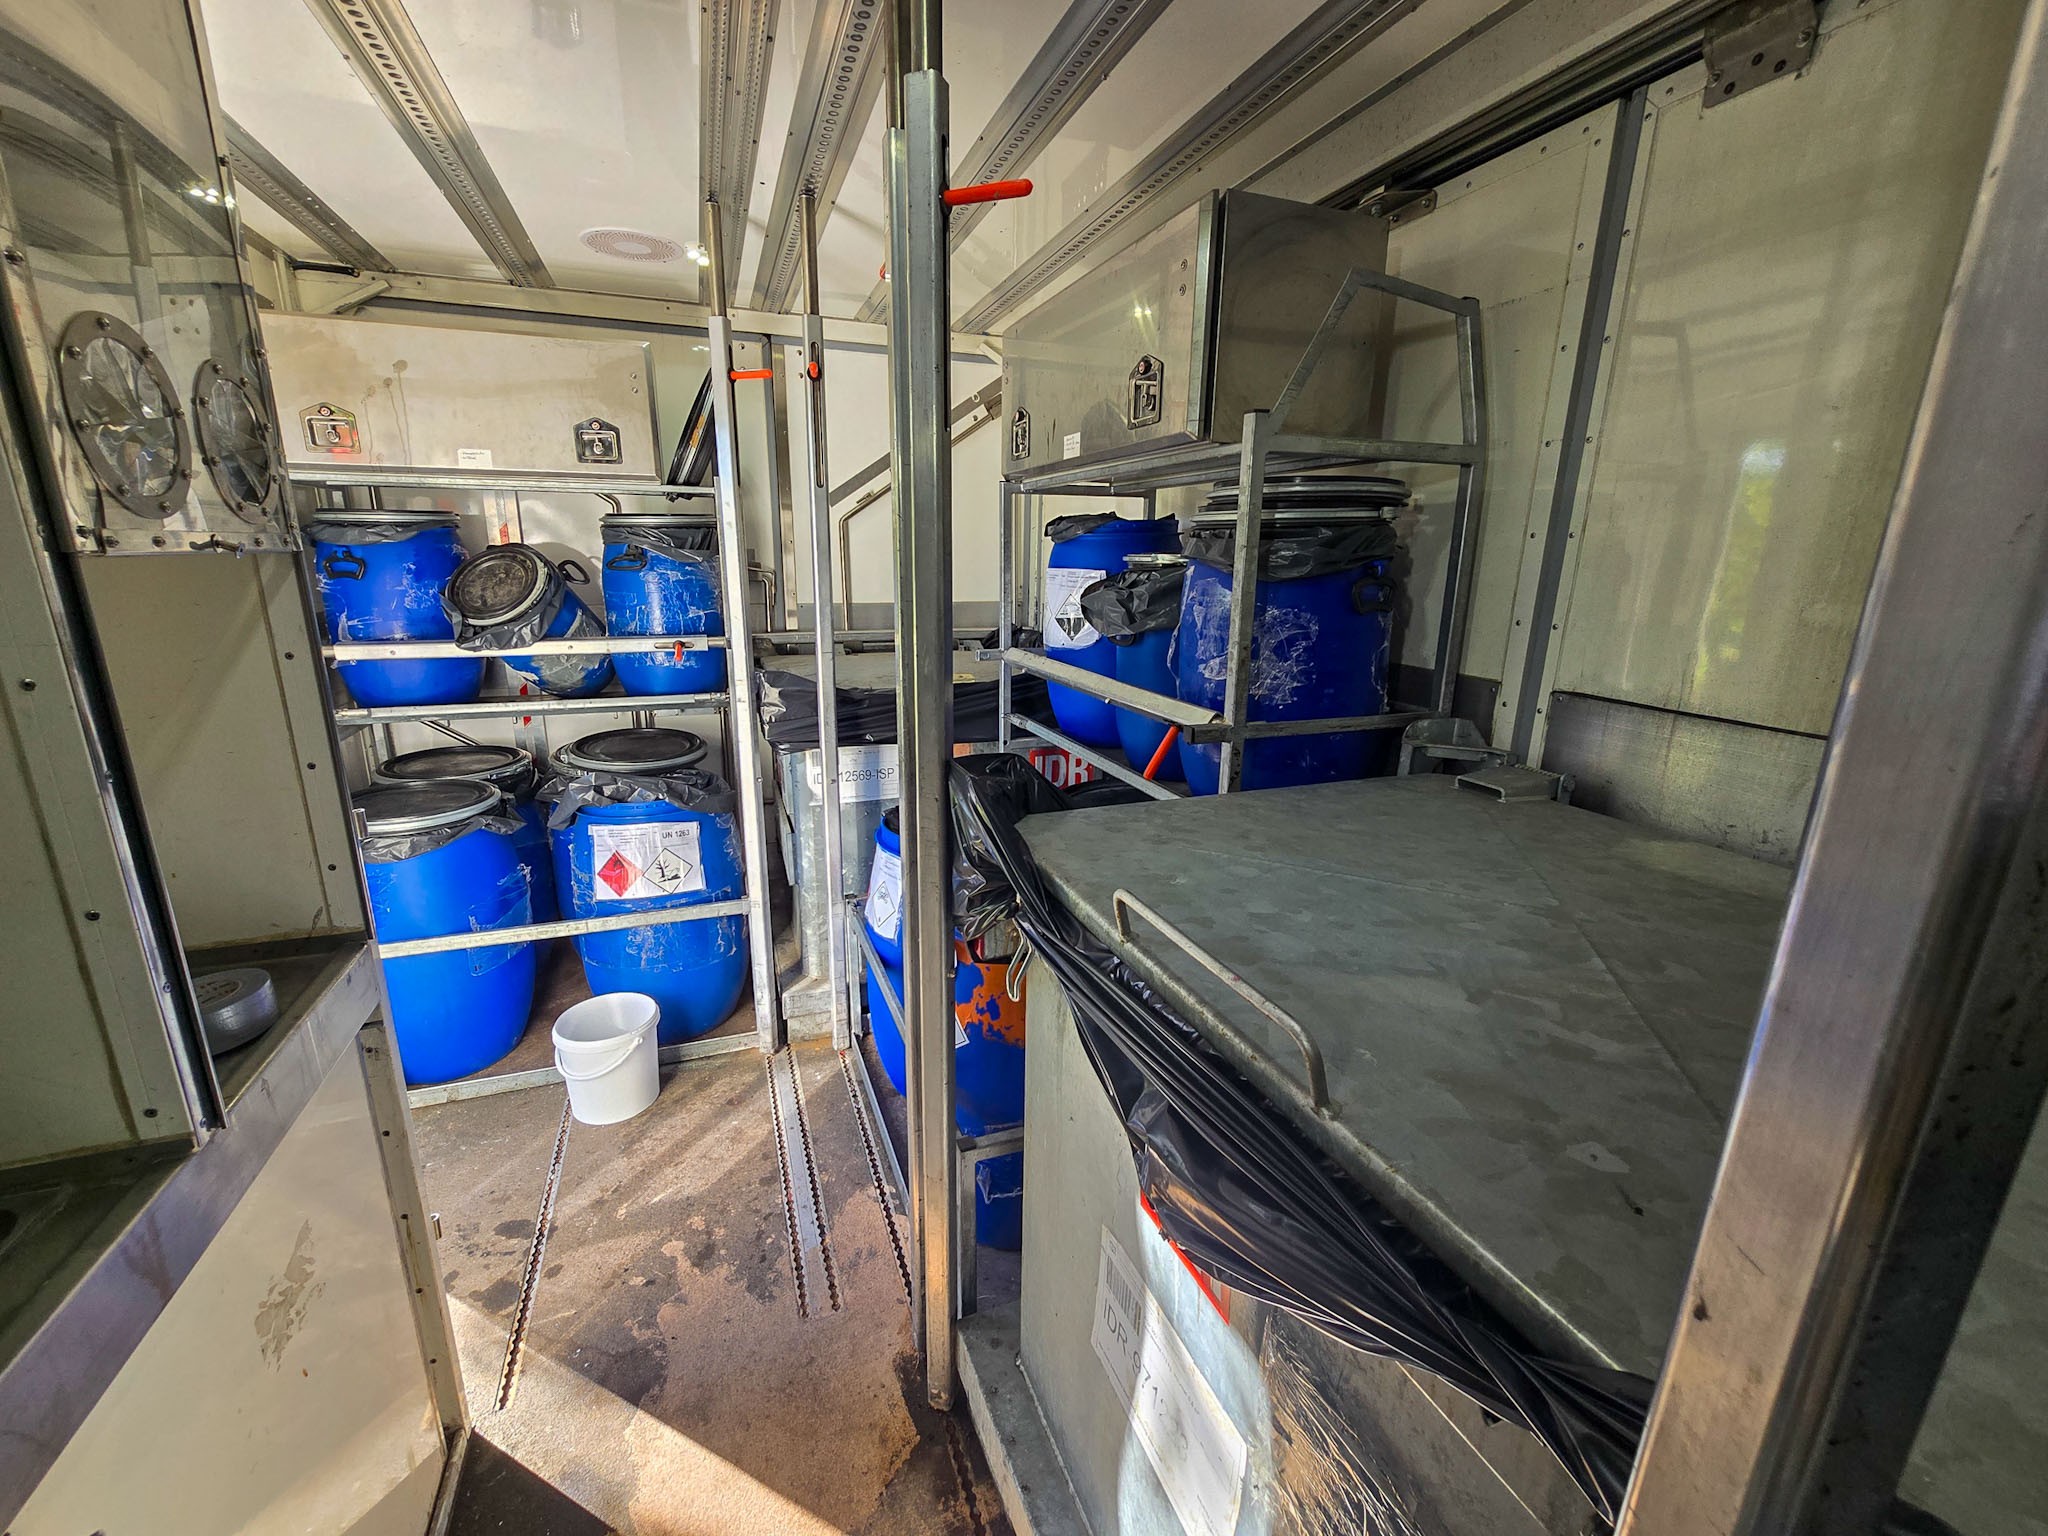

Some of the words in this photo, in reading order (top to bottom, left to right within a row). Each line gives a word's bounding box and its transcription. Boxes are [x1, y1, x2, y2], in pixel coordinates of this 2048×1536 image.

[1035, 754, 1089, 787] IDR
[662, 831, 673, 839] UN
[675, 829, 690, 838] 1263
